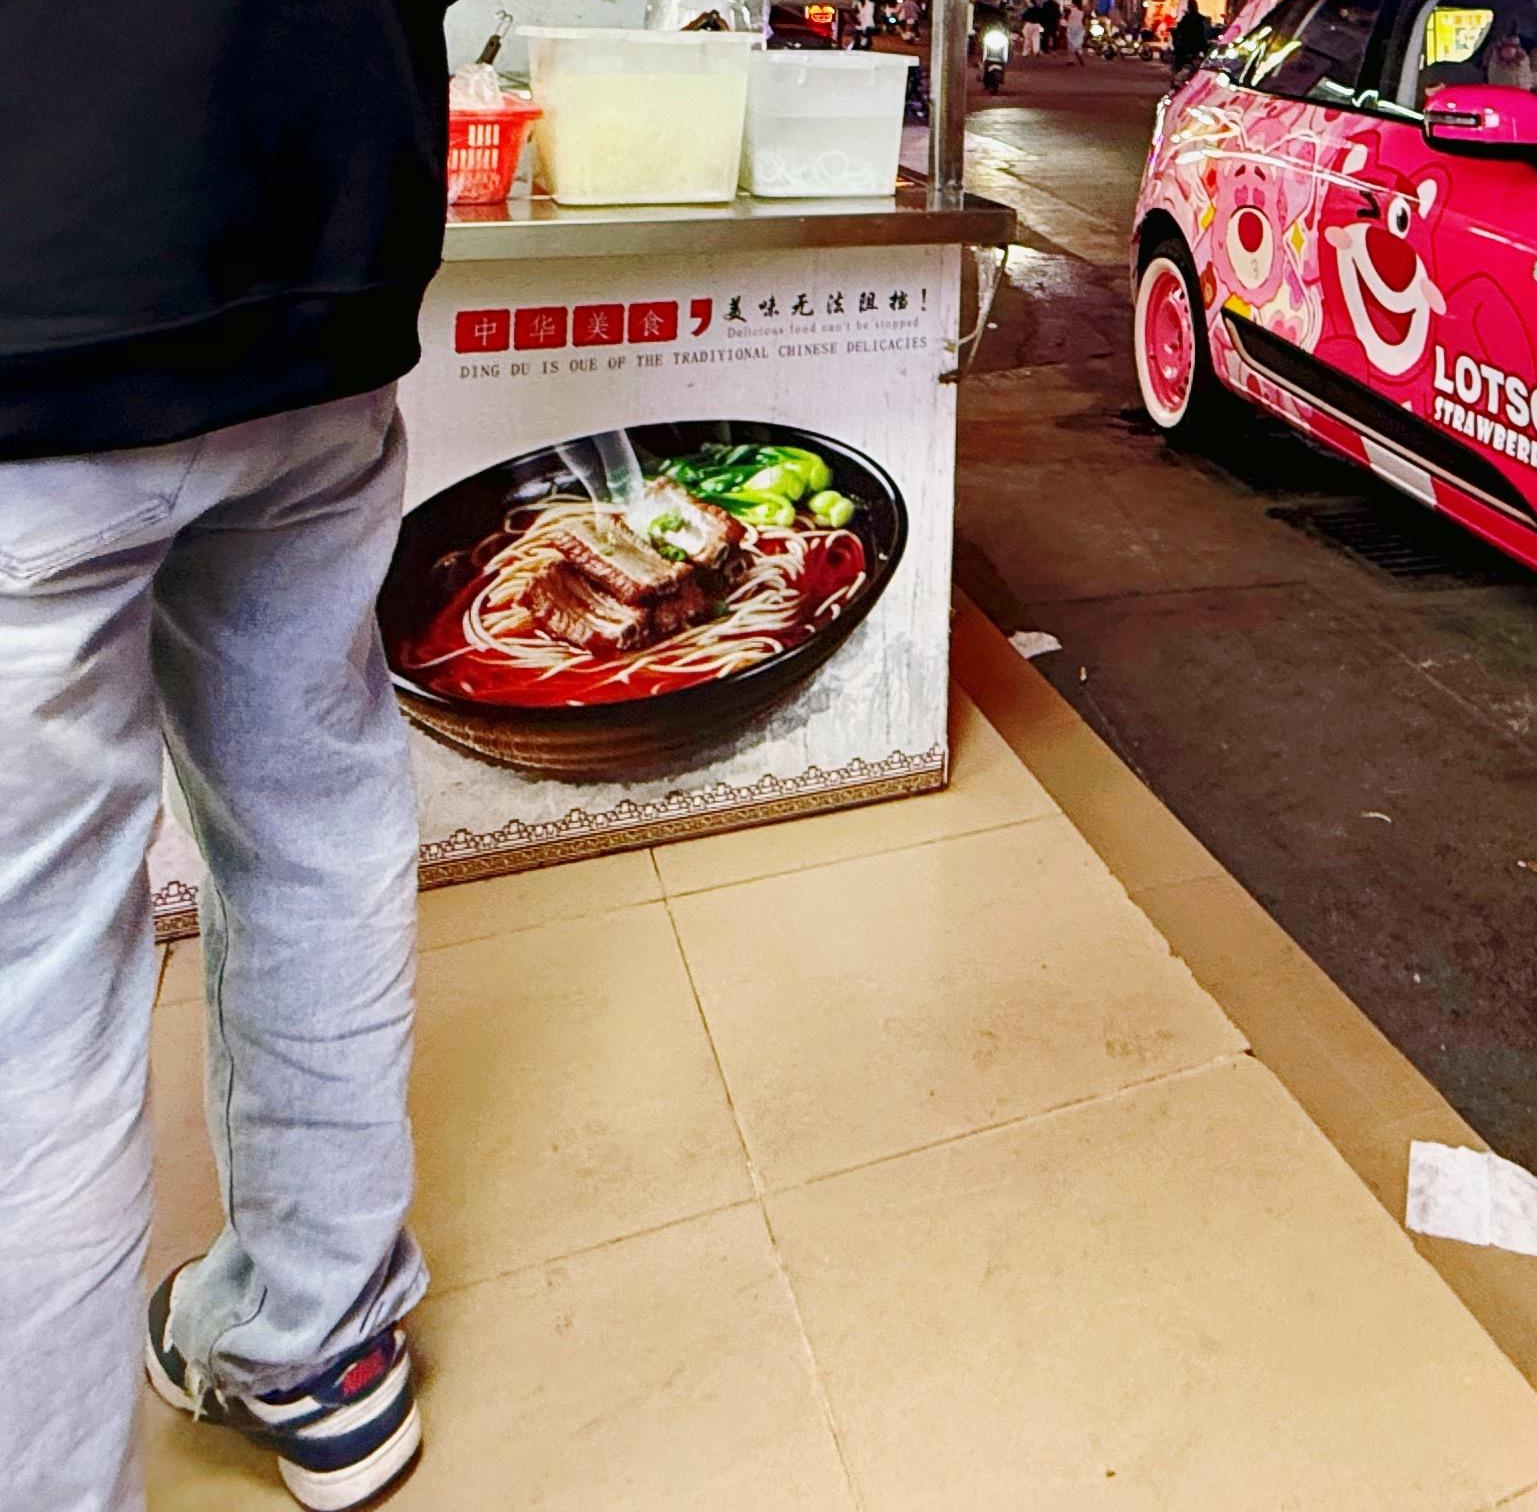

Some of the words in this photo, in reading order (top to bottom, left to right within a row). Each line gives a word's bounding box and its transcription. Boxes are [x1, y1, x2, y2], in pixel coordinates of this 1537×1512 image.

[723, 288, 927, 323] 美味无法阻挡!
[727, 324, 784, 338] Delicious
[789, 322, 816, 335] food
[821, 320, 851, 333] can't
[856, 319, 869, 331] be
[875, 317, 919, 331] stopped
[460, 364, 500, 379] DING
[511, 362, 530, 376] DU
[542, 360, 559, 375] IS
[608, 356, 626, 370] OF
[637, 353, 663, 368] THE
[777, 341, 837, 358] CHINESE
[847, 337, 928, 354] DELICACIES
